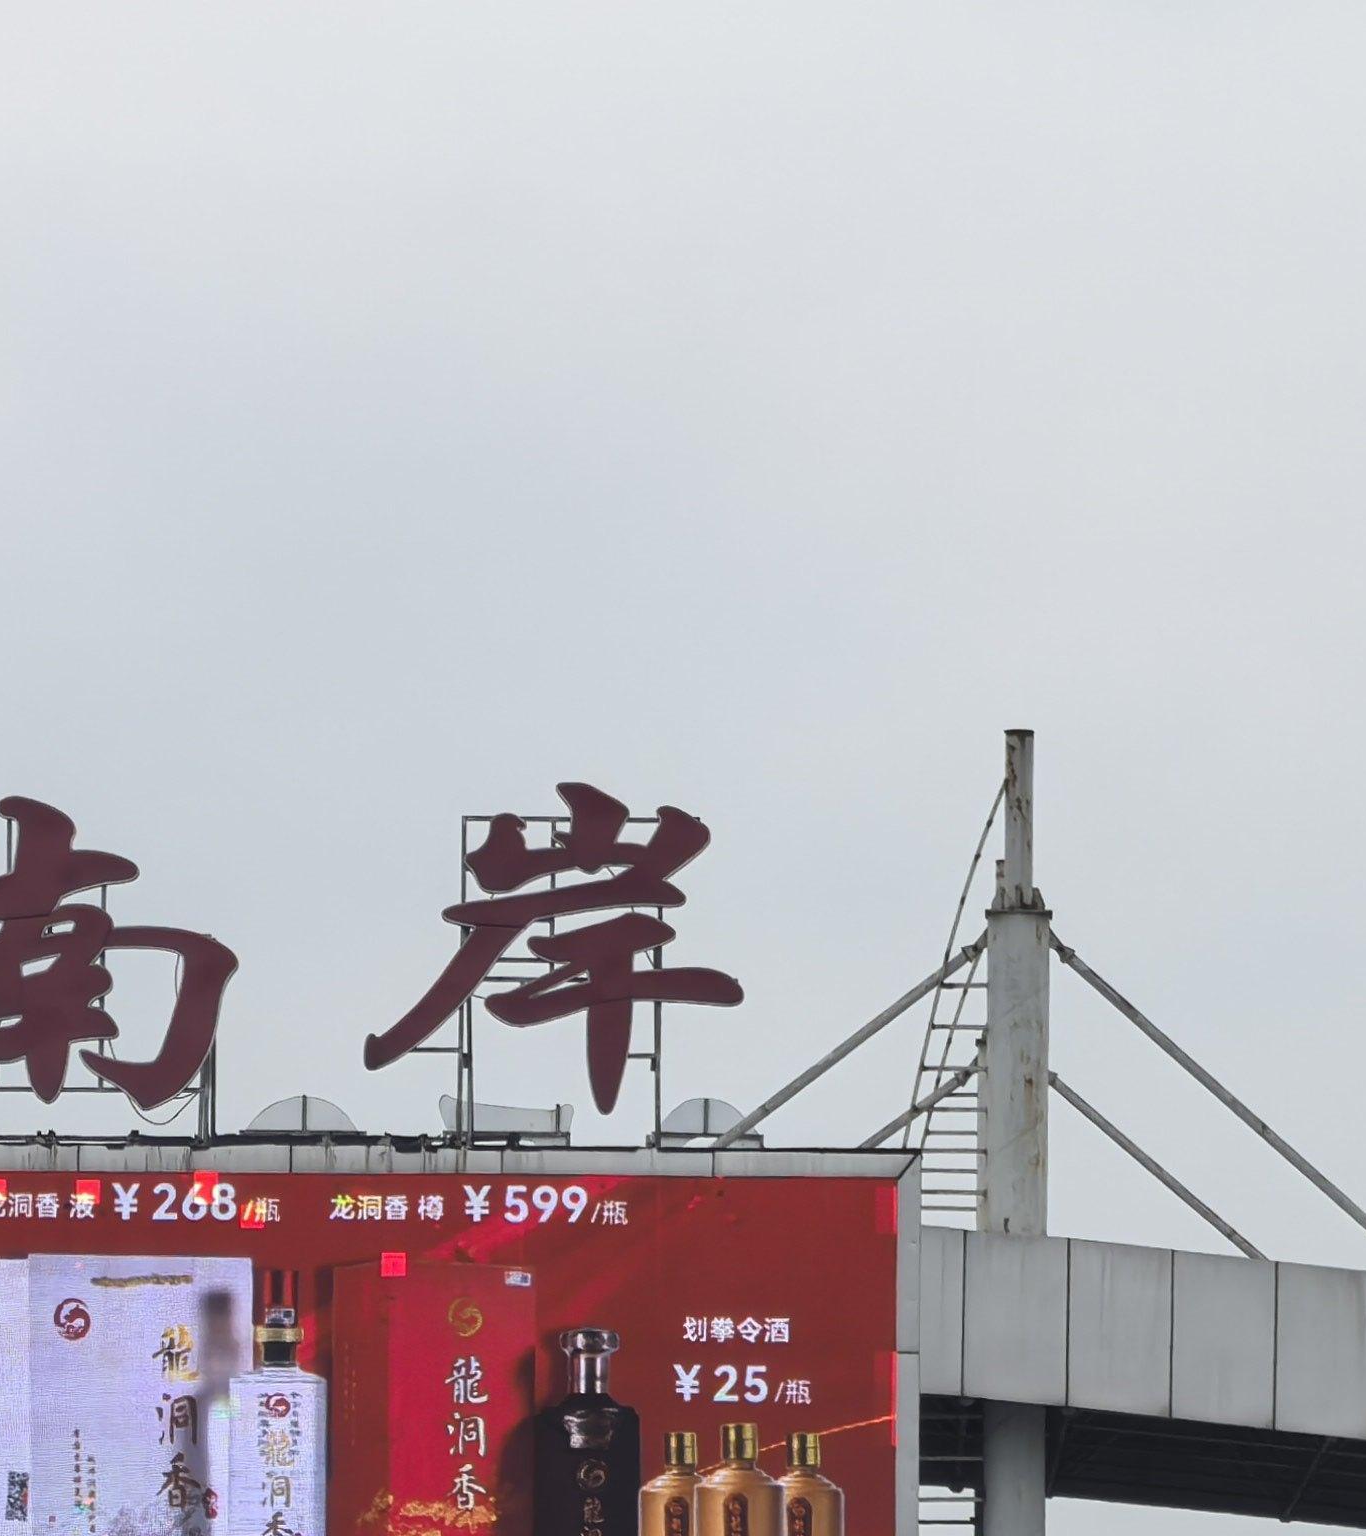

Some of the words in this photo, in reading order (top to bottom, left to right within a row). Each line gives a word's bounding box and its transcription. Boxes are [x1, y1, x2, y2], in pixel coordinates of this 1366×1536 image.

[69, 1191, 96, 1219] 液
[329, 1194, 408, 1221] 龙洞香
[418, 1194, 445, 1221] 樽
[444, 1356, 490, 1512] 龍洞香
